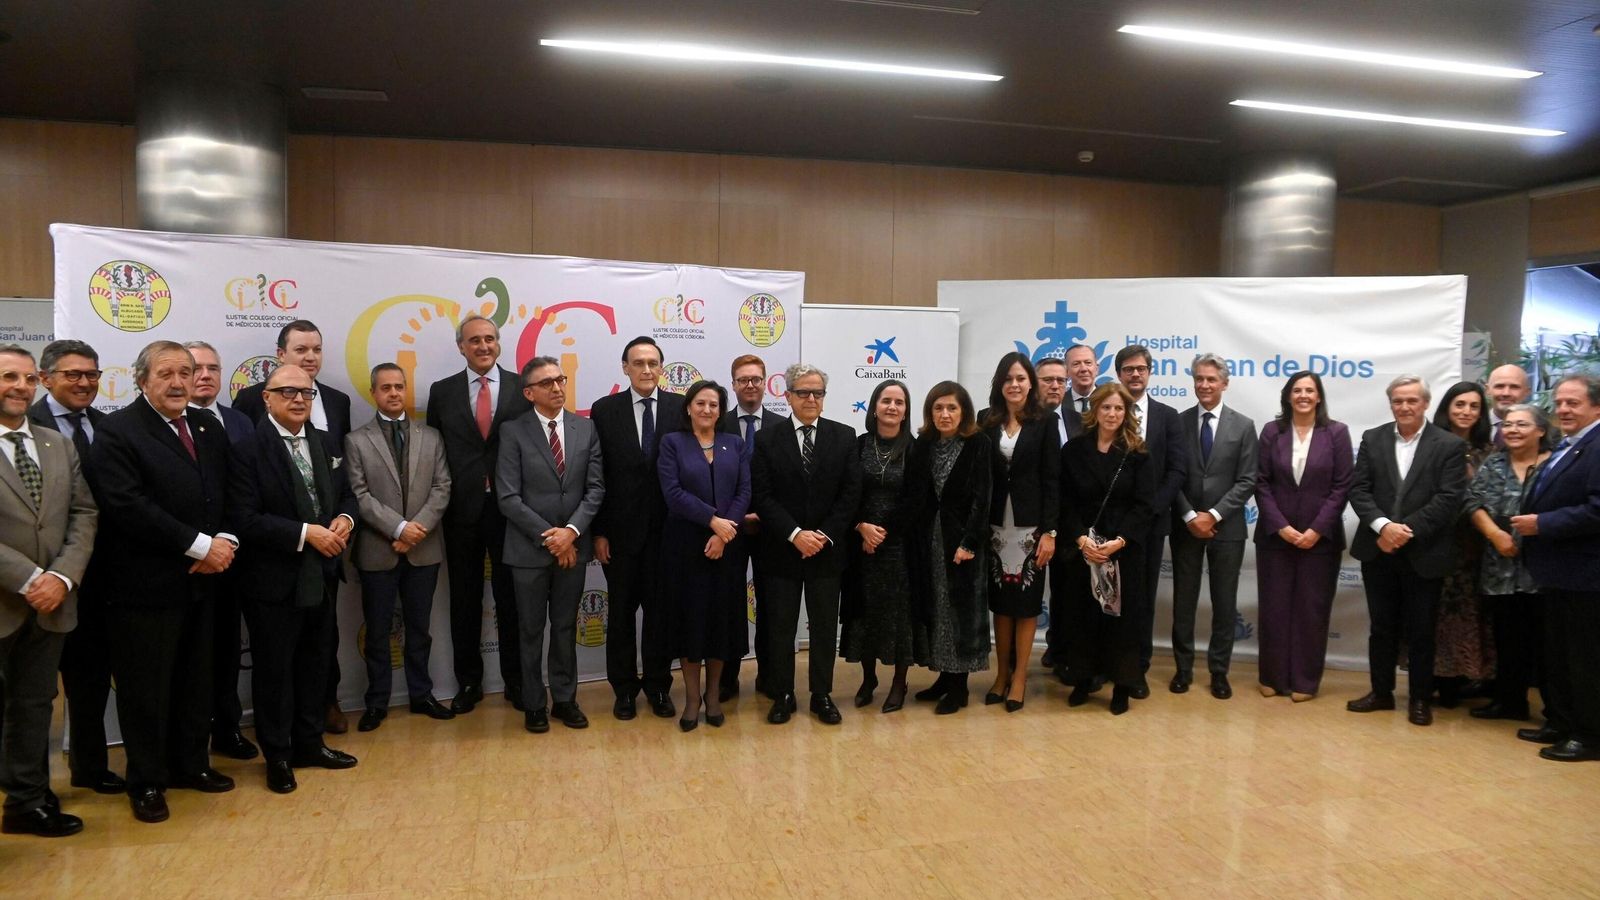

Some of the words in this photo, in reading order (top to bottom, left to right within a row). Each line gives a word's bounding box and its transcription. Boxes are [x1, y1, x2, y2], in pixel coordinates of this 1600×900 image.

[235, 320, 262, 328] MÉDICOS
[18, 332, 45, 341] Juan
[47, 333, 55, 341] d
[1126, 335, 1198, 352] Hospital
[1150, 357, 1177, 377] an
[1184, 353, 1255, 377] Jan
[1263, 354, 1300, 378] de
[1308, 354, 1375, 378] Dios
[855, 367, 907, 379] CaixaBank
[1146, 385, 1187, 397] rdoba
[1337, 571, 1359, 581] San
